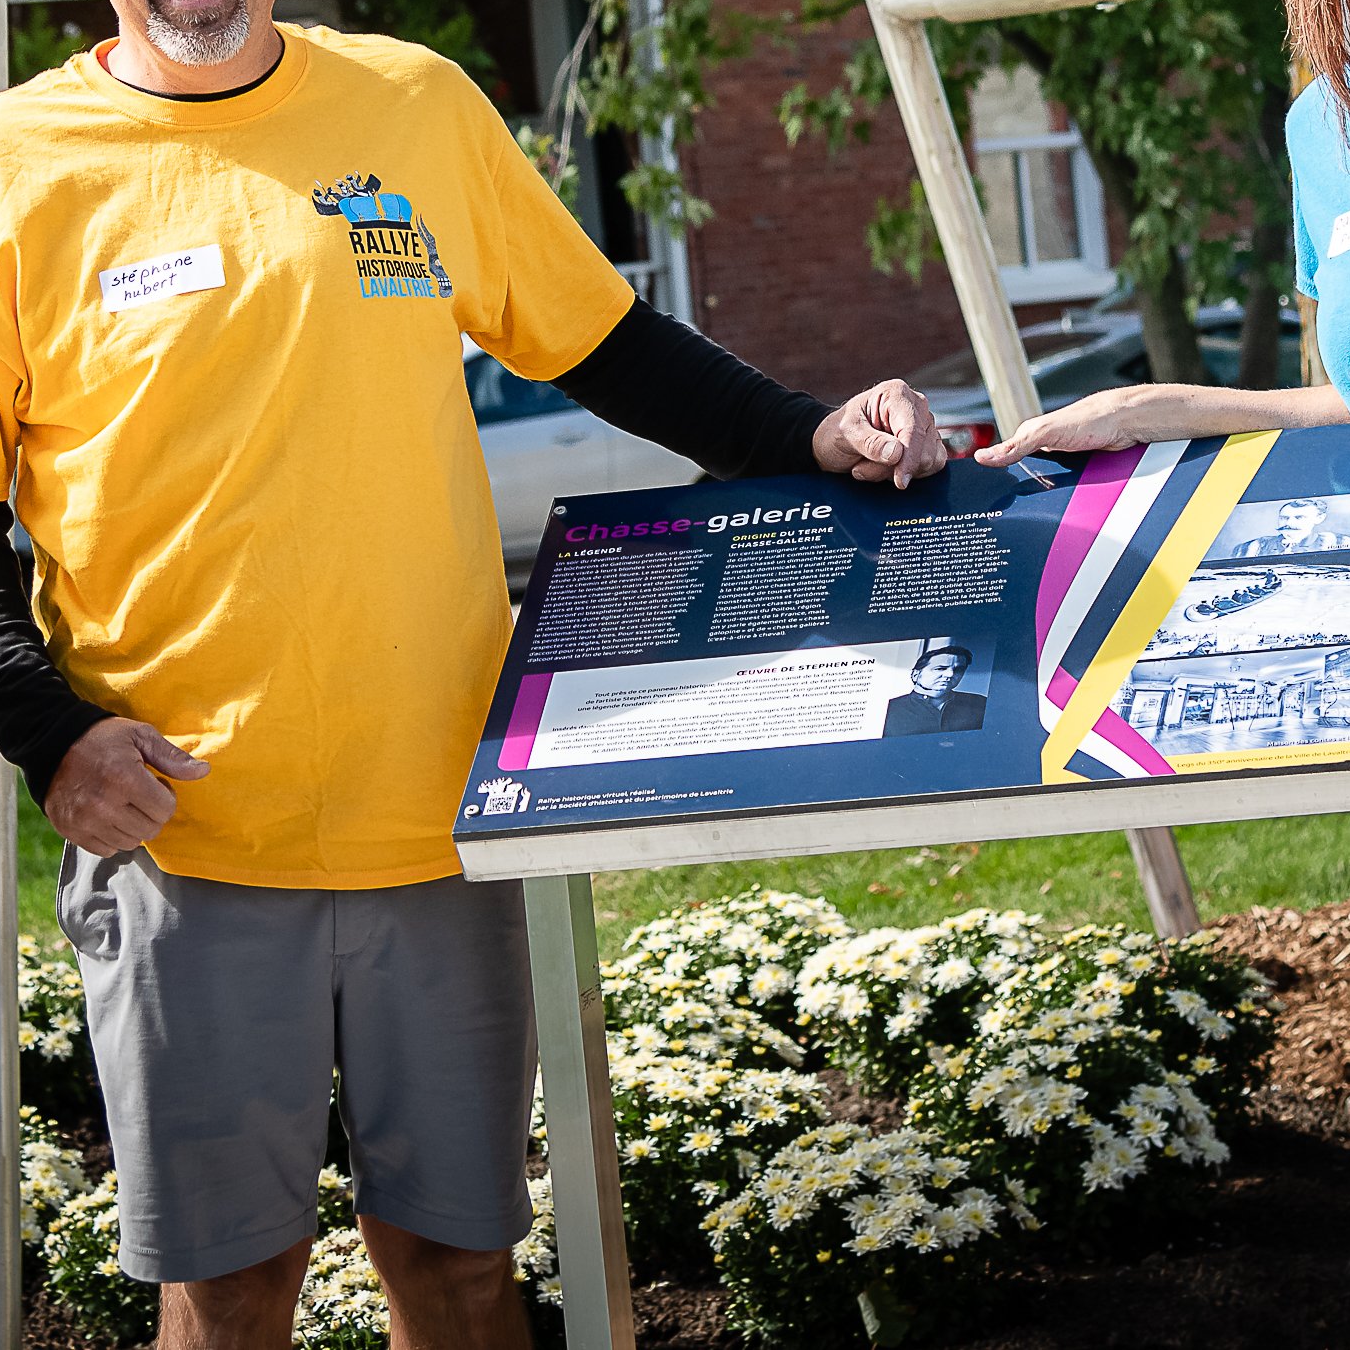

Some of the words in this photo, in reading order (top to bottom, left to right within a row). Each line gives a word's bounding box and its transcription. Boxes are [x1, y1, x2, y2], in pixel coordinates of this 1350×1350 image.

[349, 230, 422, 257] RALLYE
[356, 260, 430, 279] HISTORIQUE
[360, 278, 436, 298] LAVALTRIE
[565, 503, 832, 542] Chasse-galerie
[885, 516, 932, 527] HONORÉ
[934, 511, 1003, 523] BEAUGRAND
[732, 532, 776, 541] ORIGINE
[798, 527, 833, 535] TERME
[730, 536, 821, 549] CHASSE-GALERIE
[574, 547, 622, 557] LÉGENDE
[798, 661, 848, 671] STEPHEN
